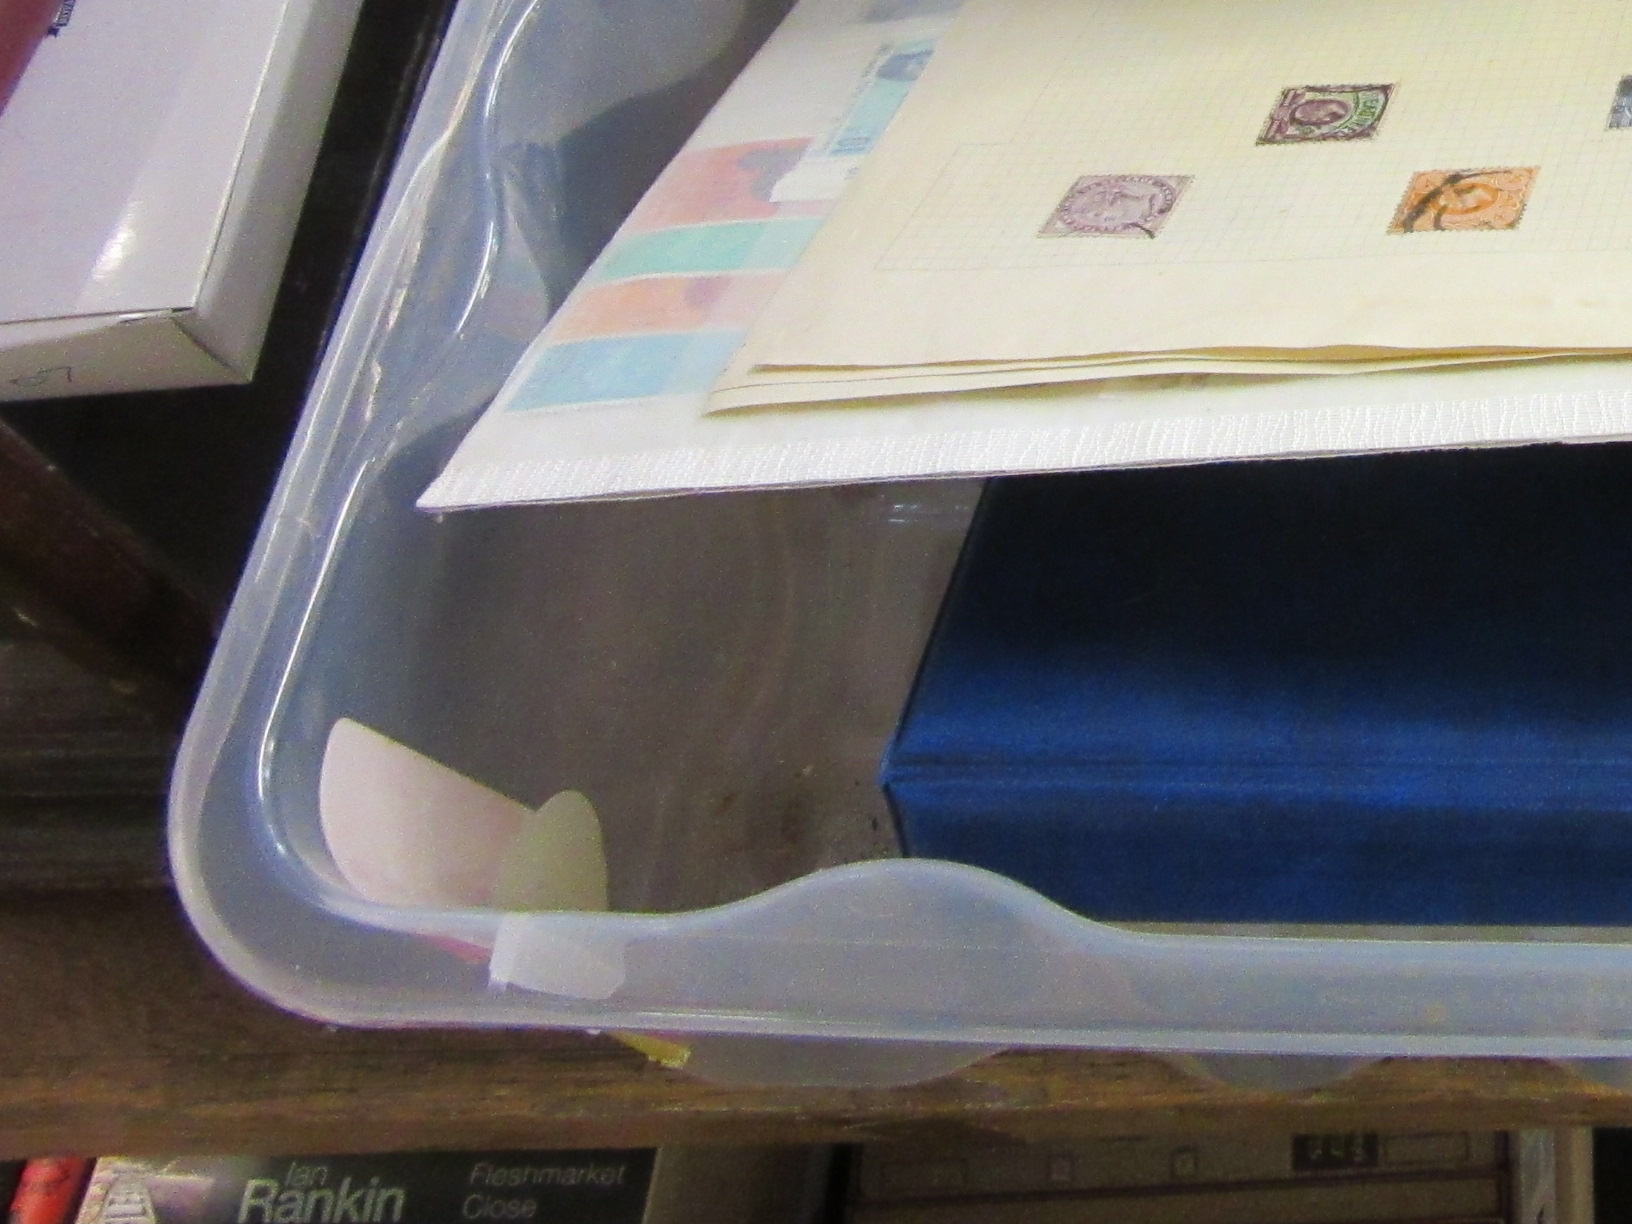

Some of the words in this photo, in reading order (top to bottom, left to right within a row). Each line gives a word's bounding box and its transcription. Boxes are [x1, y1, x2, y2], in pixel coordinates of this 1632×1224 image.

[286, 1160, 329, 1188] Ian
[469, 1162, 627, 1187] Fleshmarket
[237, 1176, 405, 1224] Rankin
[461, 1192, 539, 1220] Close
